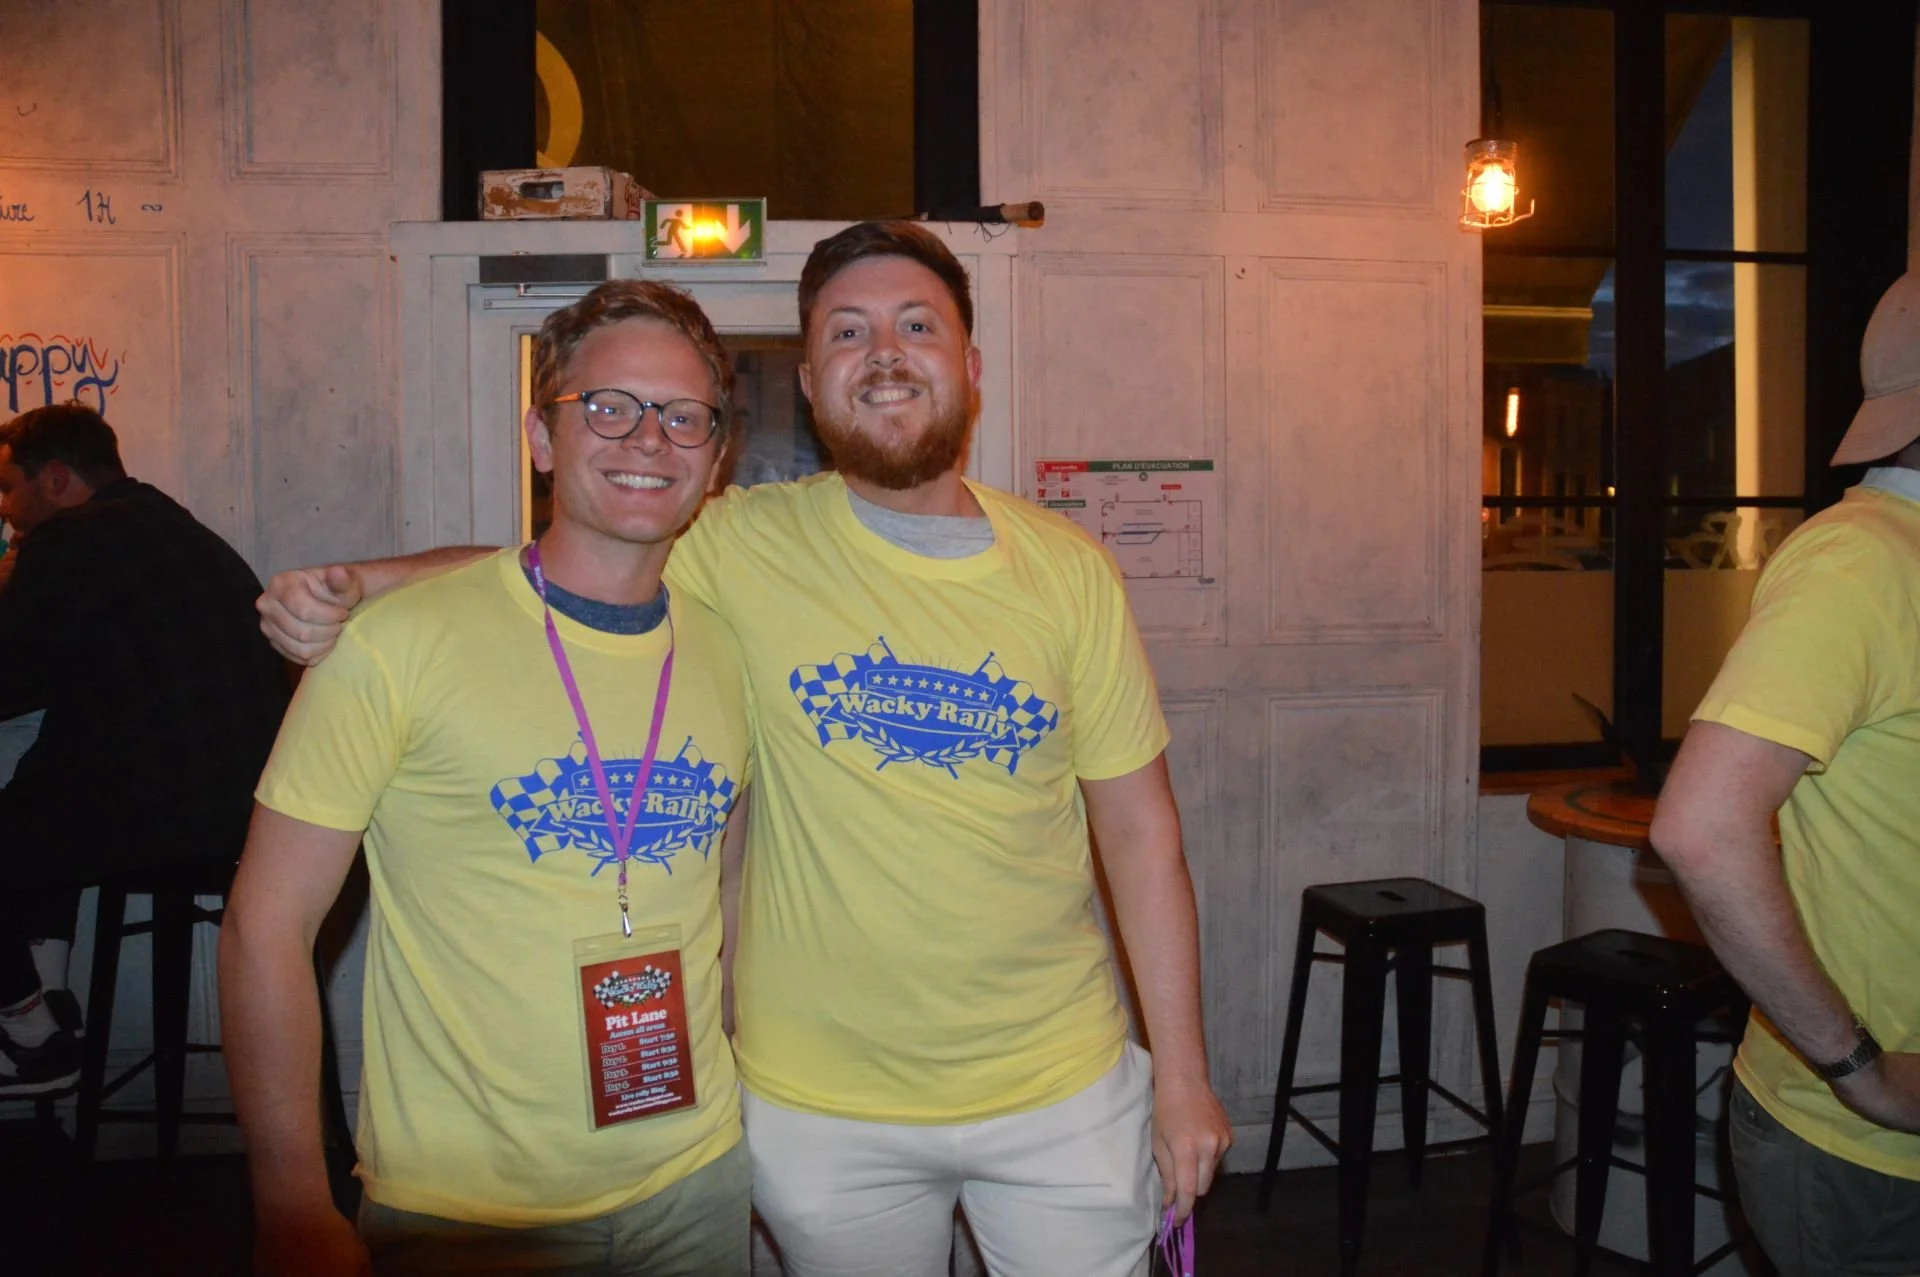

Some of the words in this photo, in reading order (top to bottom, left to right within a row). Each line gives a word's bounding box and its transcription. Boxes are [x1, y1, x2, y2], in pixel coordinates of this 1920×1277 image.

[847, 694, 930, 721] Wacky
[937, 701, 1013, 740] Rally
[646, 791, 711, 826] Rally
[605, 1014, 629, 1031] Pit
[631, 1009, 667, 1025] Lane
[640, 1048, 659, 1058] Start
[641, 1061, 660, 1071] Start
[643, 1073, 661, 1083] Start
